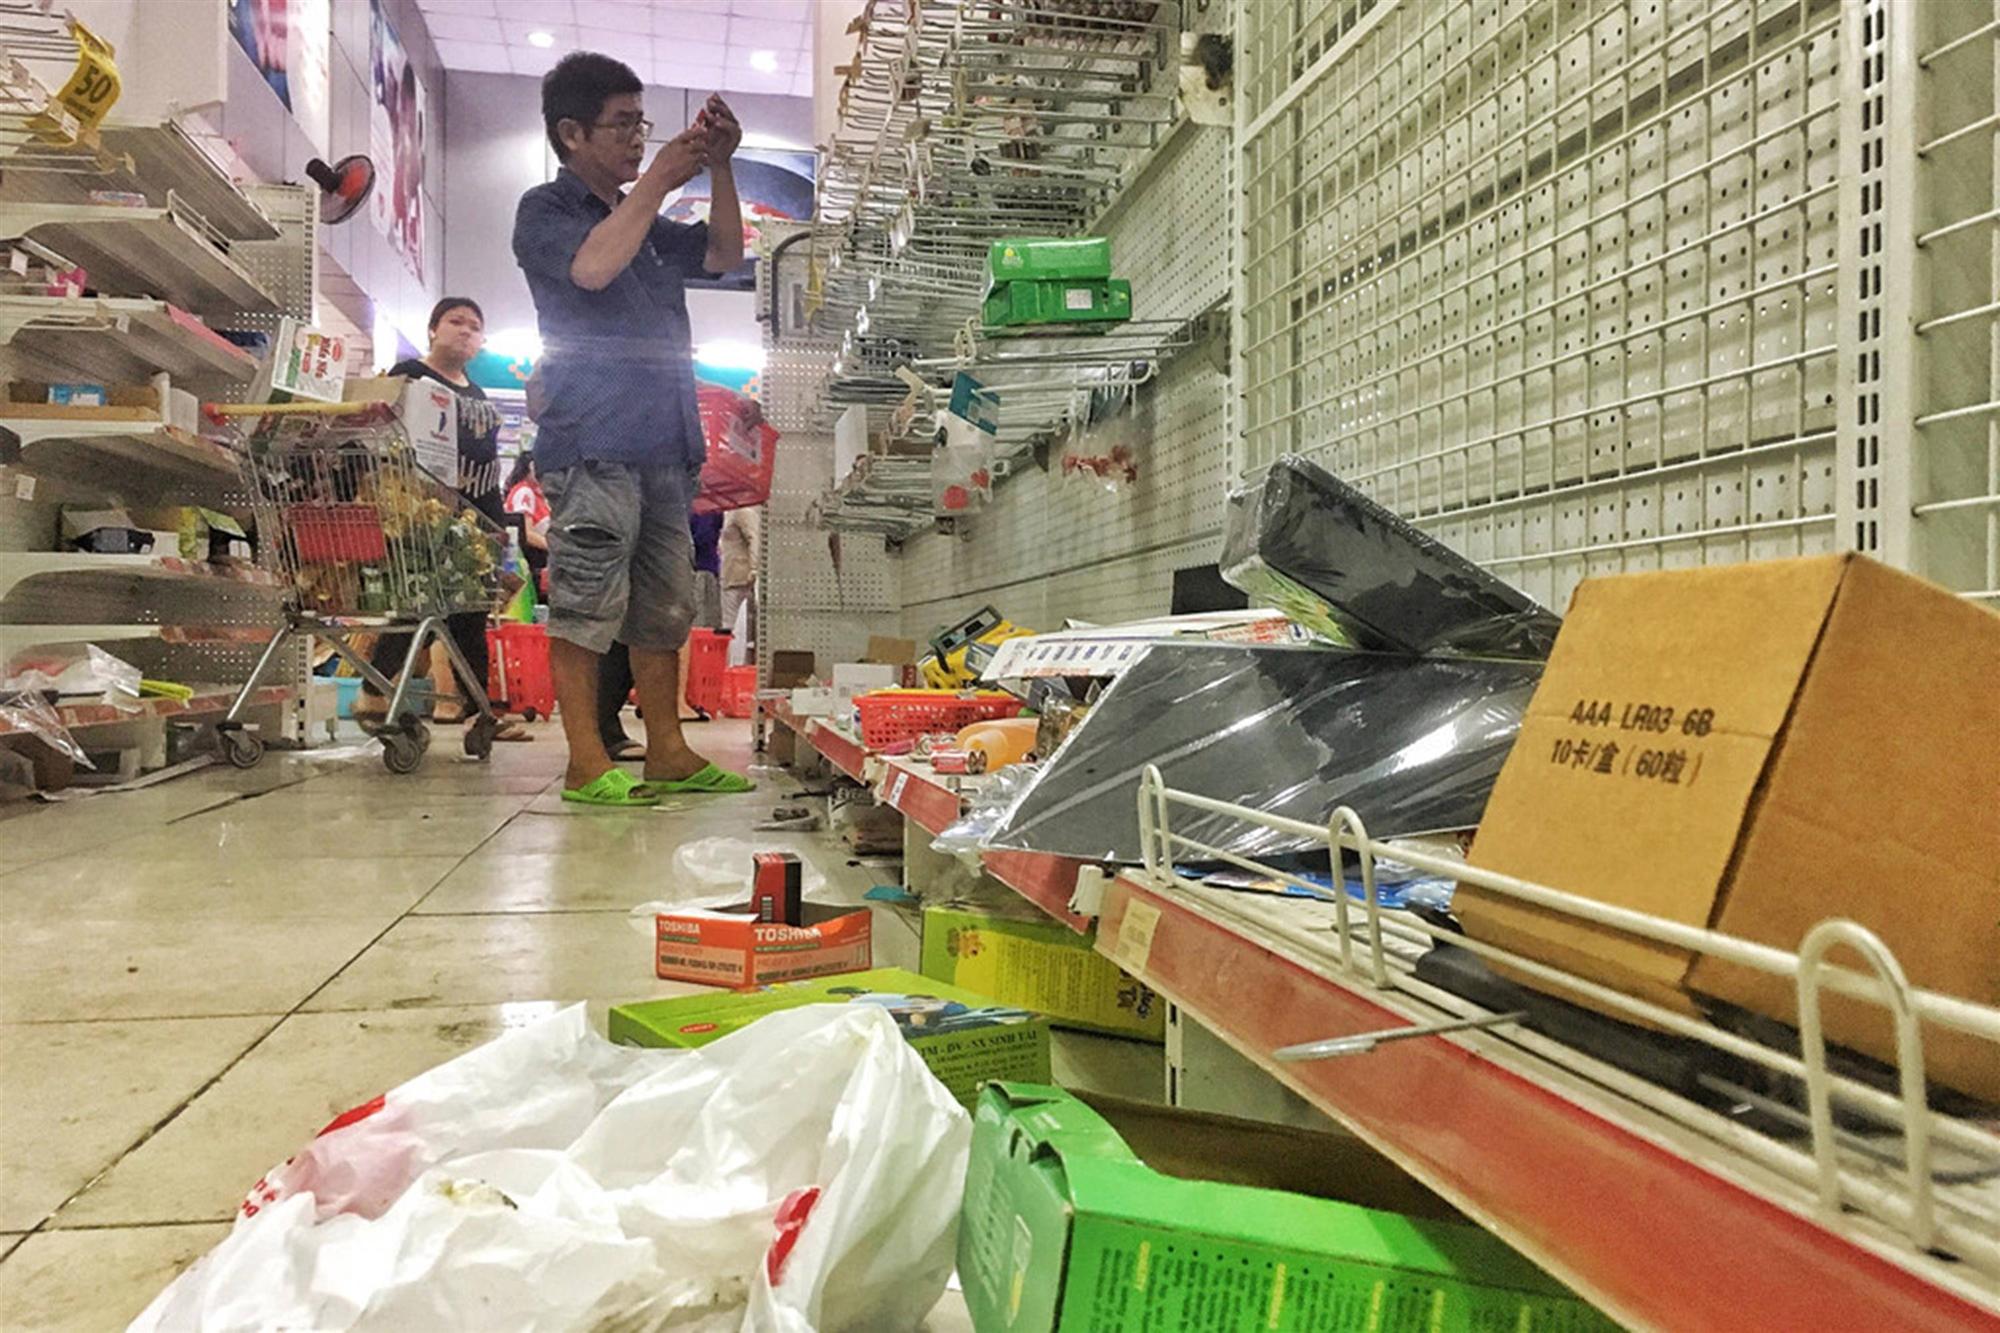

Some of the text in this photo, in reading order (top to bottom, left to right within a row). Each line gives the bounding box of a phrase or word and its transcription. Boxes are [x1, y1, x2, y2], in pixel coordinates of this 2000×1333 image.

[74, 65, 112, 104] 50
[1569, 699, 1715, 737] AAA LR03 6B
[659, 920, 700, 934] TOSHIBA
[754, 927, 822, 943] TOSHIBA
